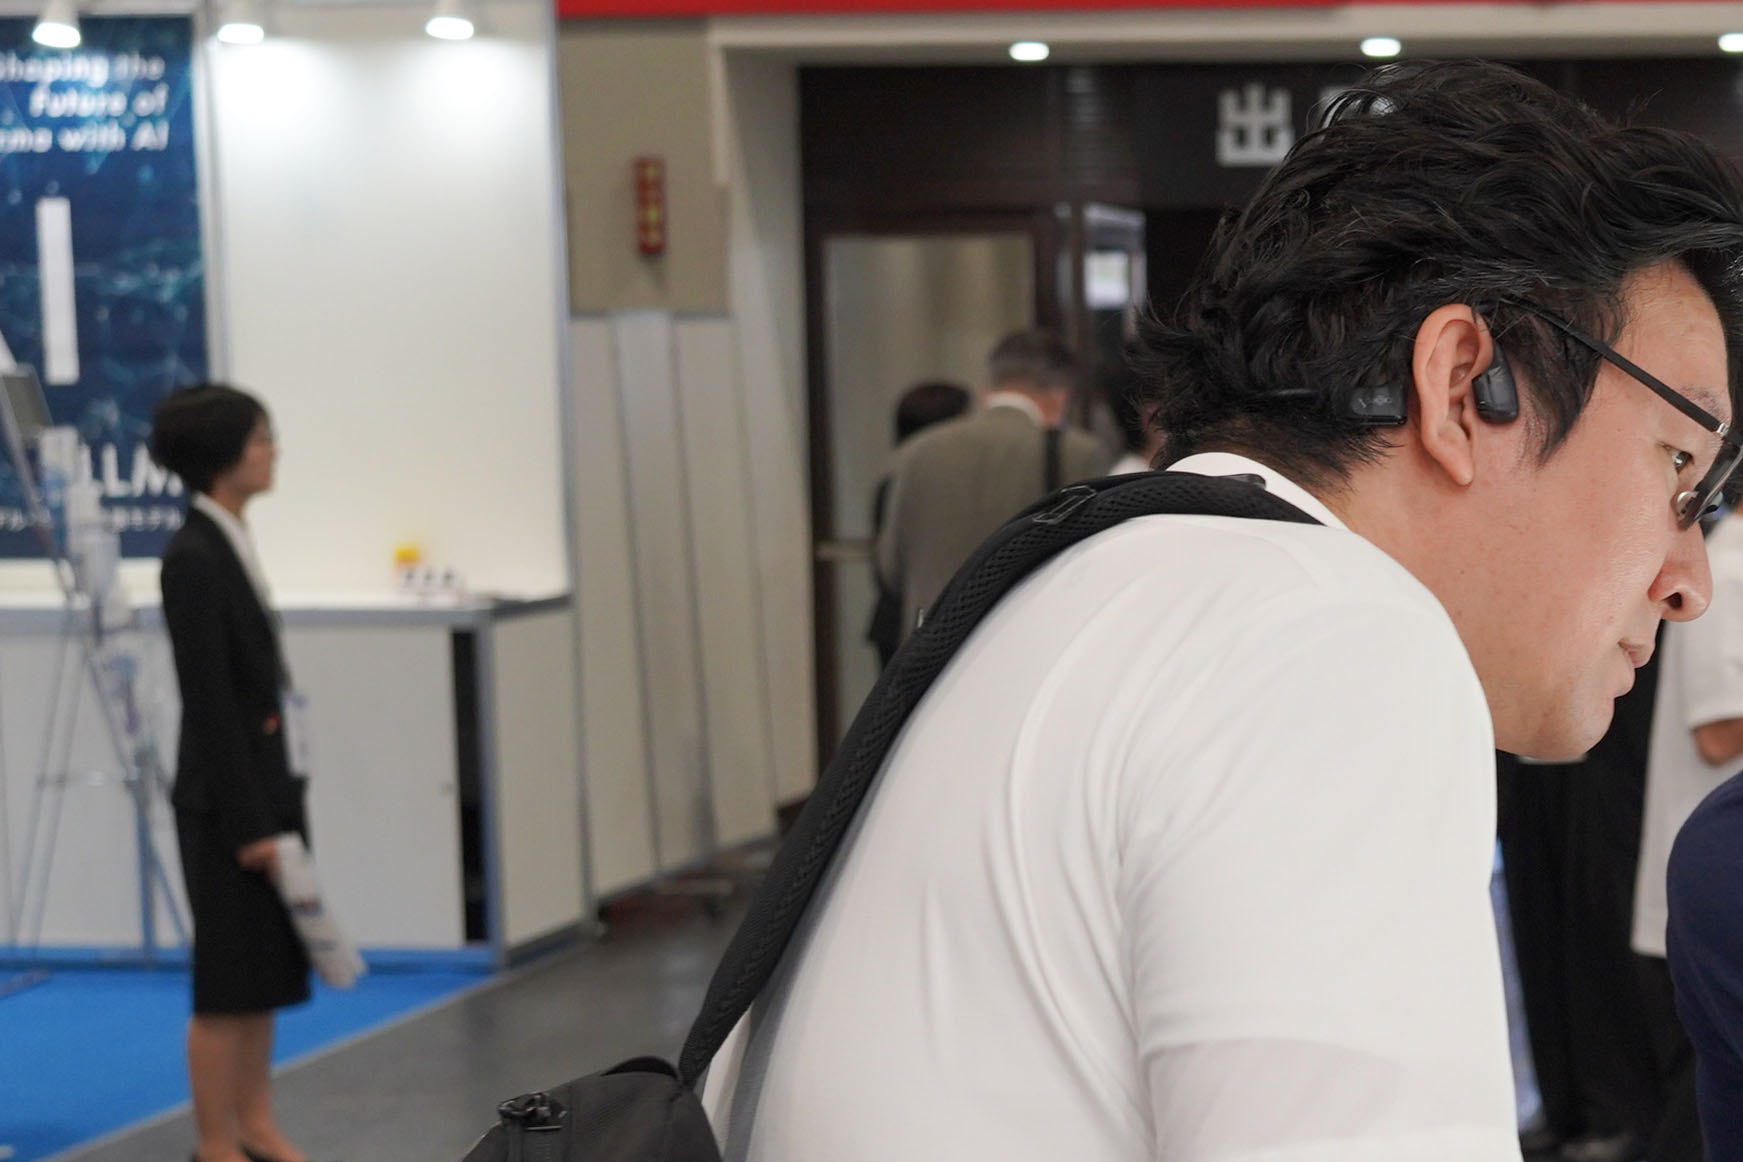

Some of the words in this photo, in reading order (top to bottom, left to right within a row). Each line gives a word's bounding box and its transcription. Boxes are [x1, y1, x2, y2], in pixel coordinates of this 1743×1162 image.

[114, 52, 166, 81] the
[133, 81, 169, 117] of
[130, 118, 170, 152] AI
